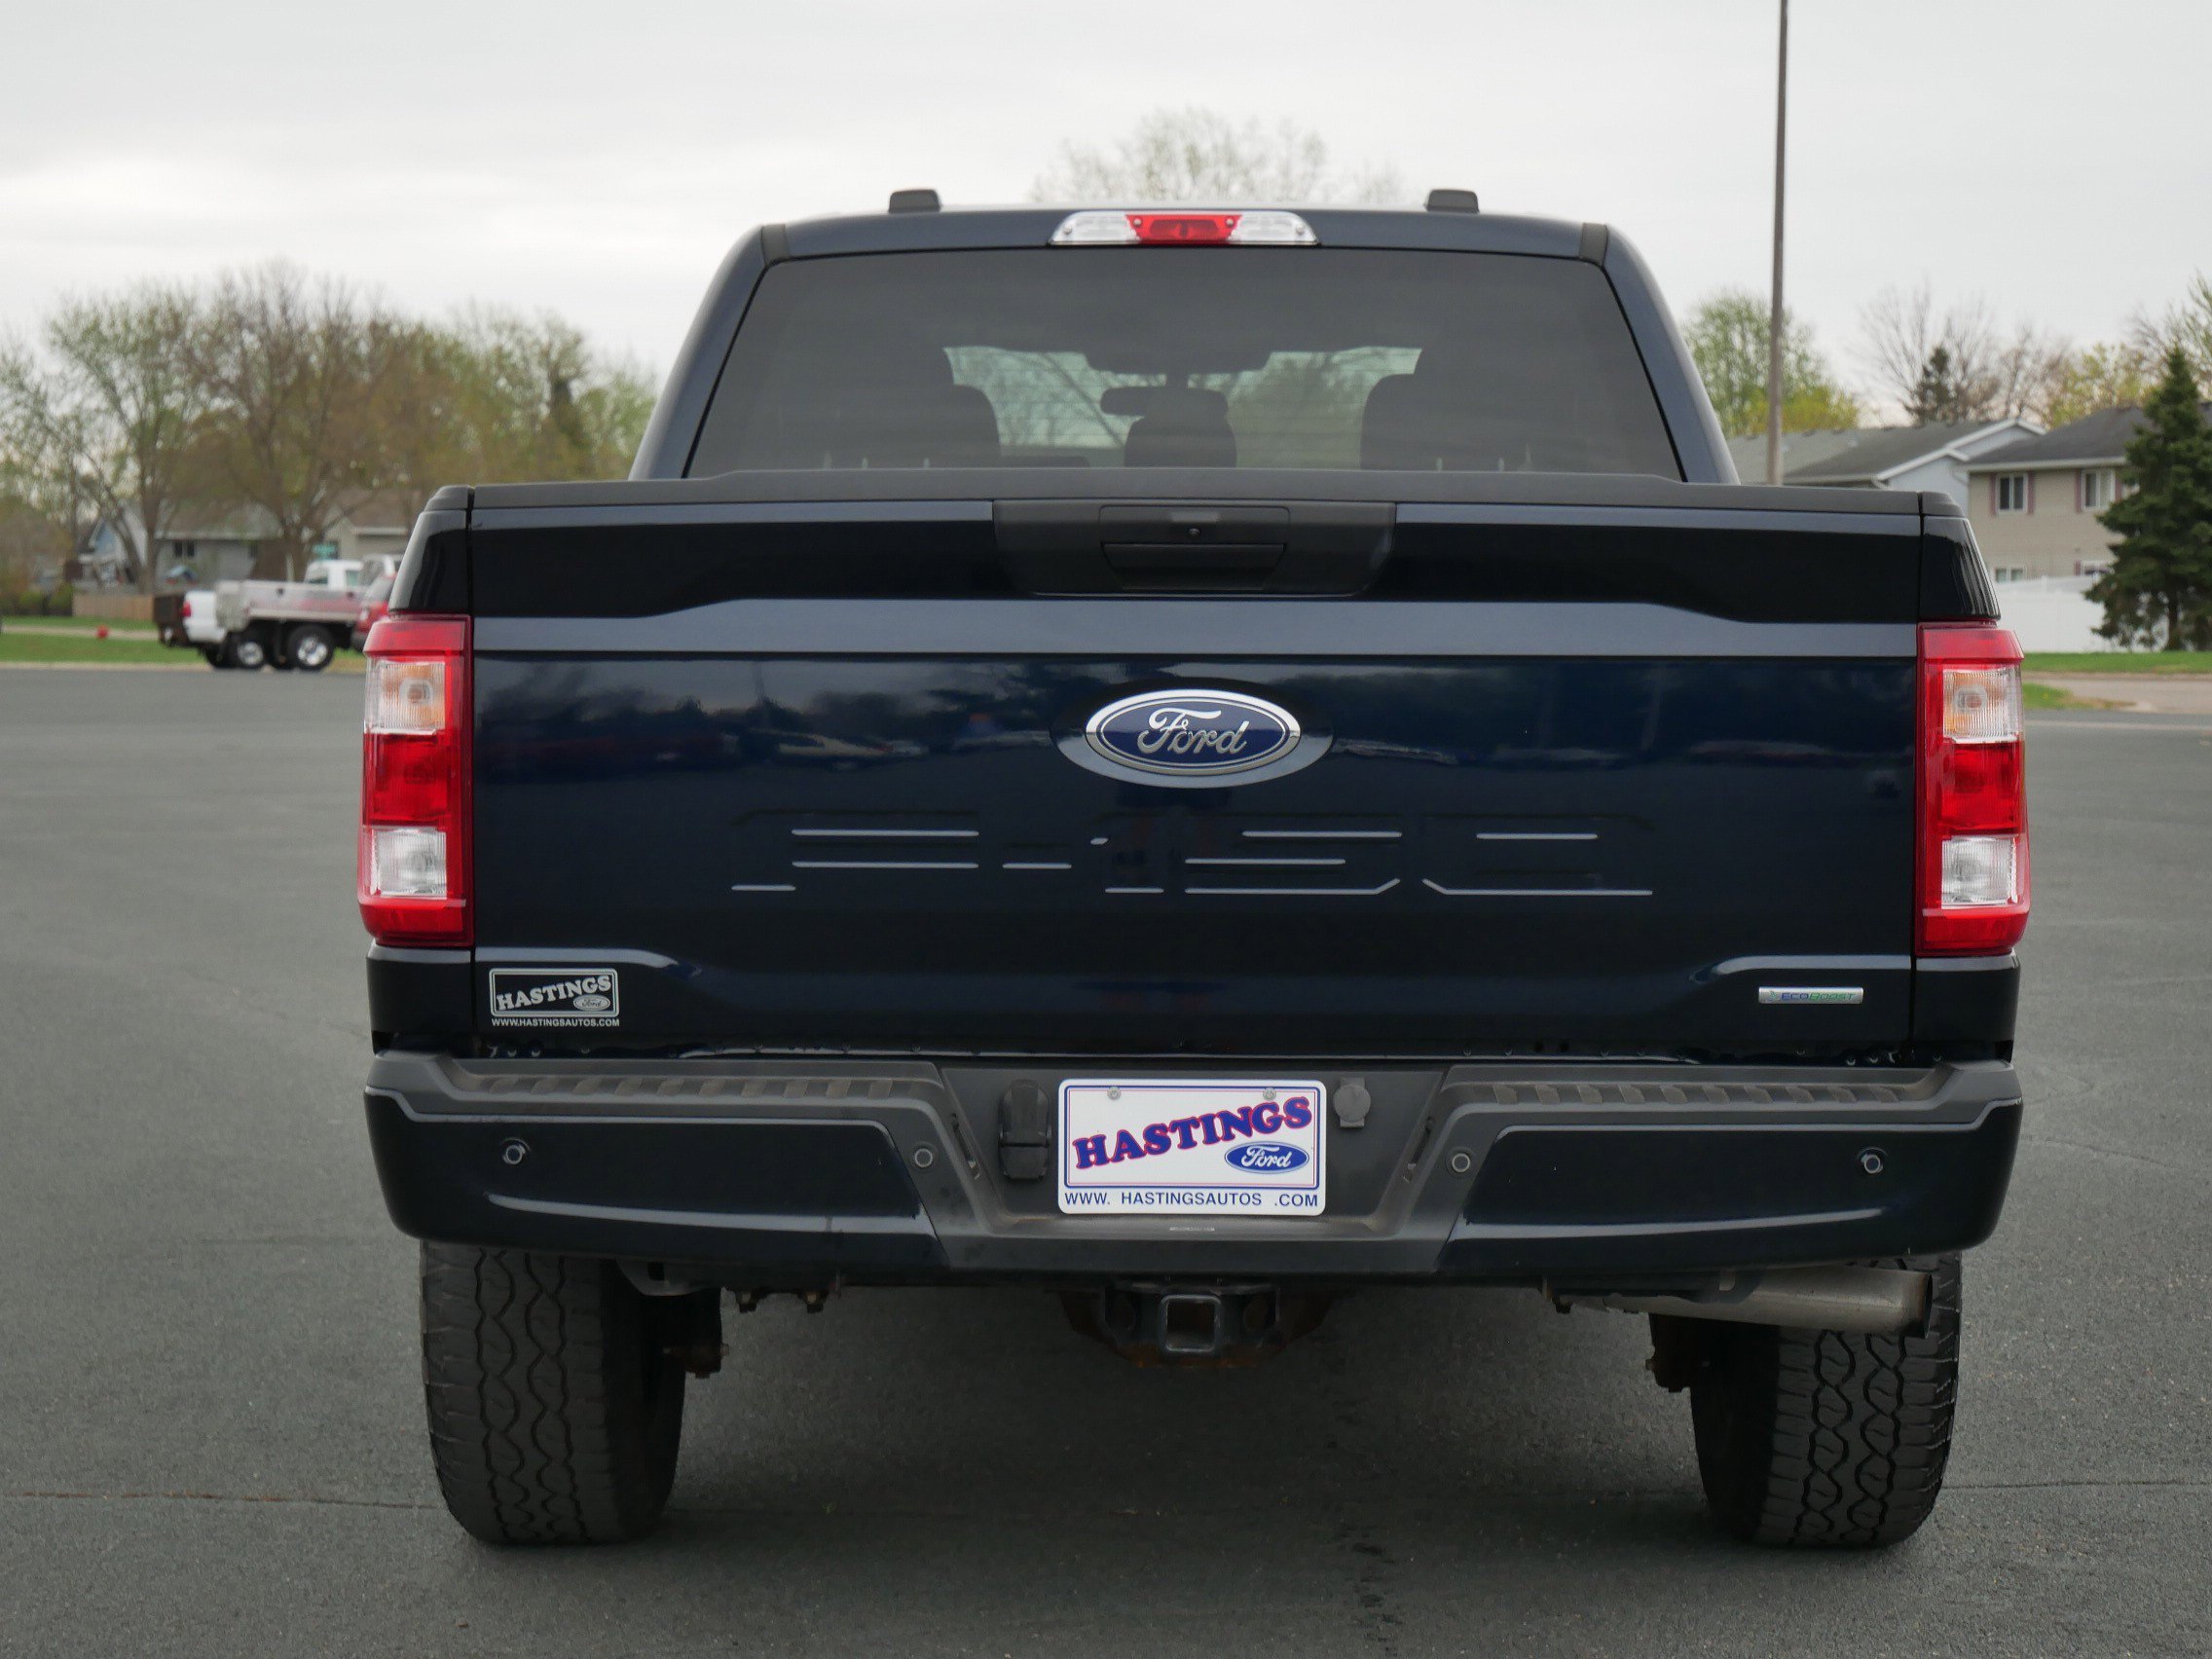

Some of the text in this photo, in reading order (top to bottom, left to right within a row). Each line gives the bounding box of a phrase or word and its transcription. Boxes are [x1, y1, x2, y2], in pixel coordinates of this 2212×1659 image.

[1137, 707, 1250, 755] Ford
[497, 976, 611, 1011] HASTINGS
[492, 1018, 620, 1027] WWW.HASTINGSAUTOS.COM
[1072, 1096, 1312, 1169] HASTINGS
[1240, 1145, 1292, 1169] Ford
